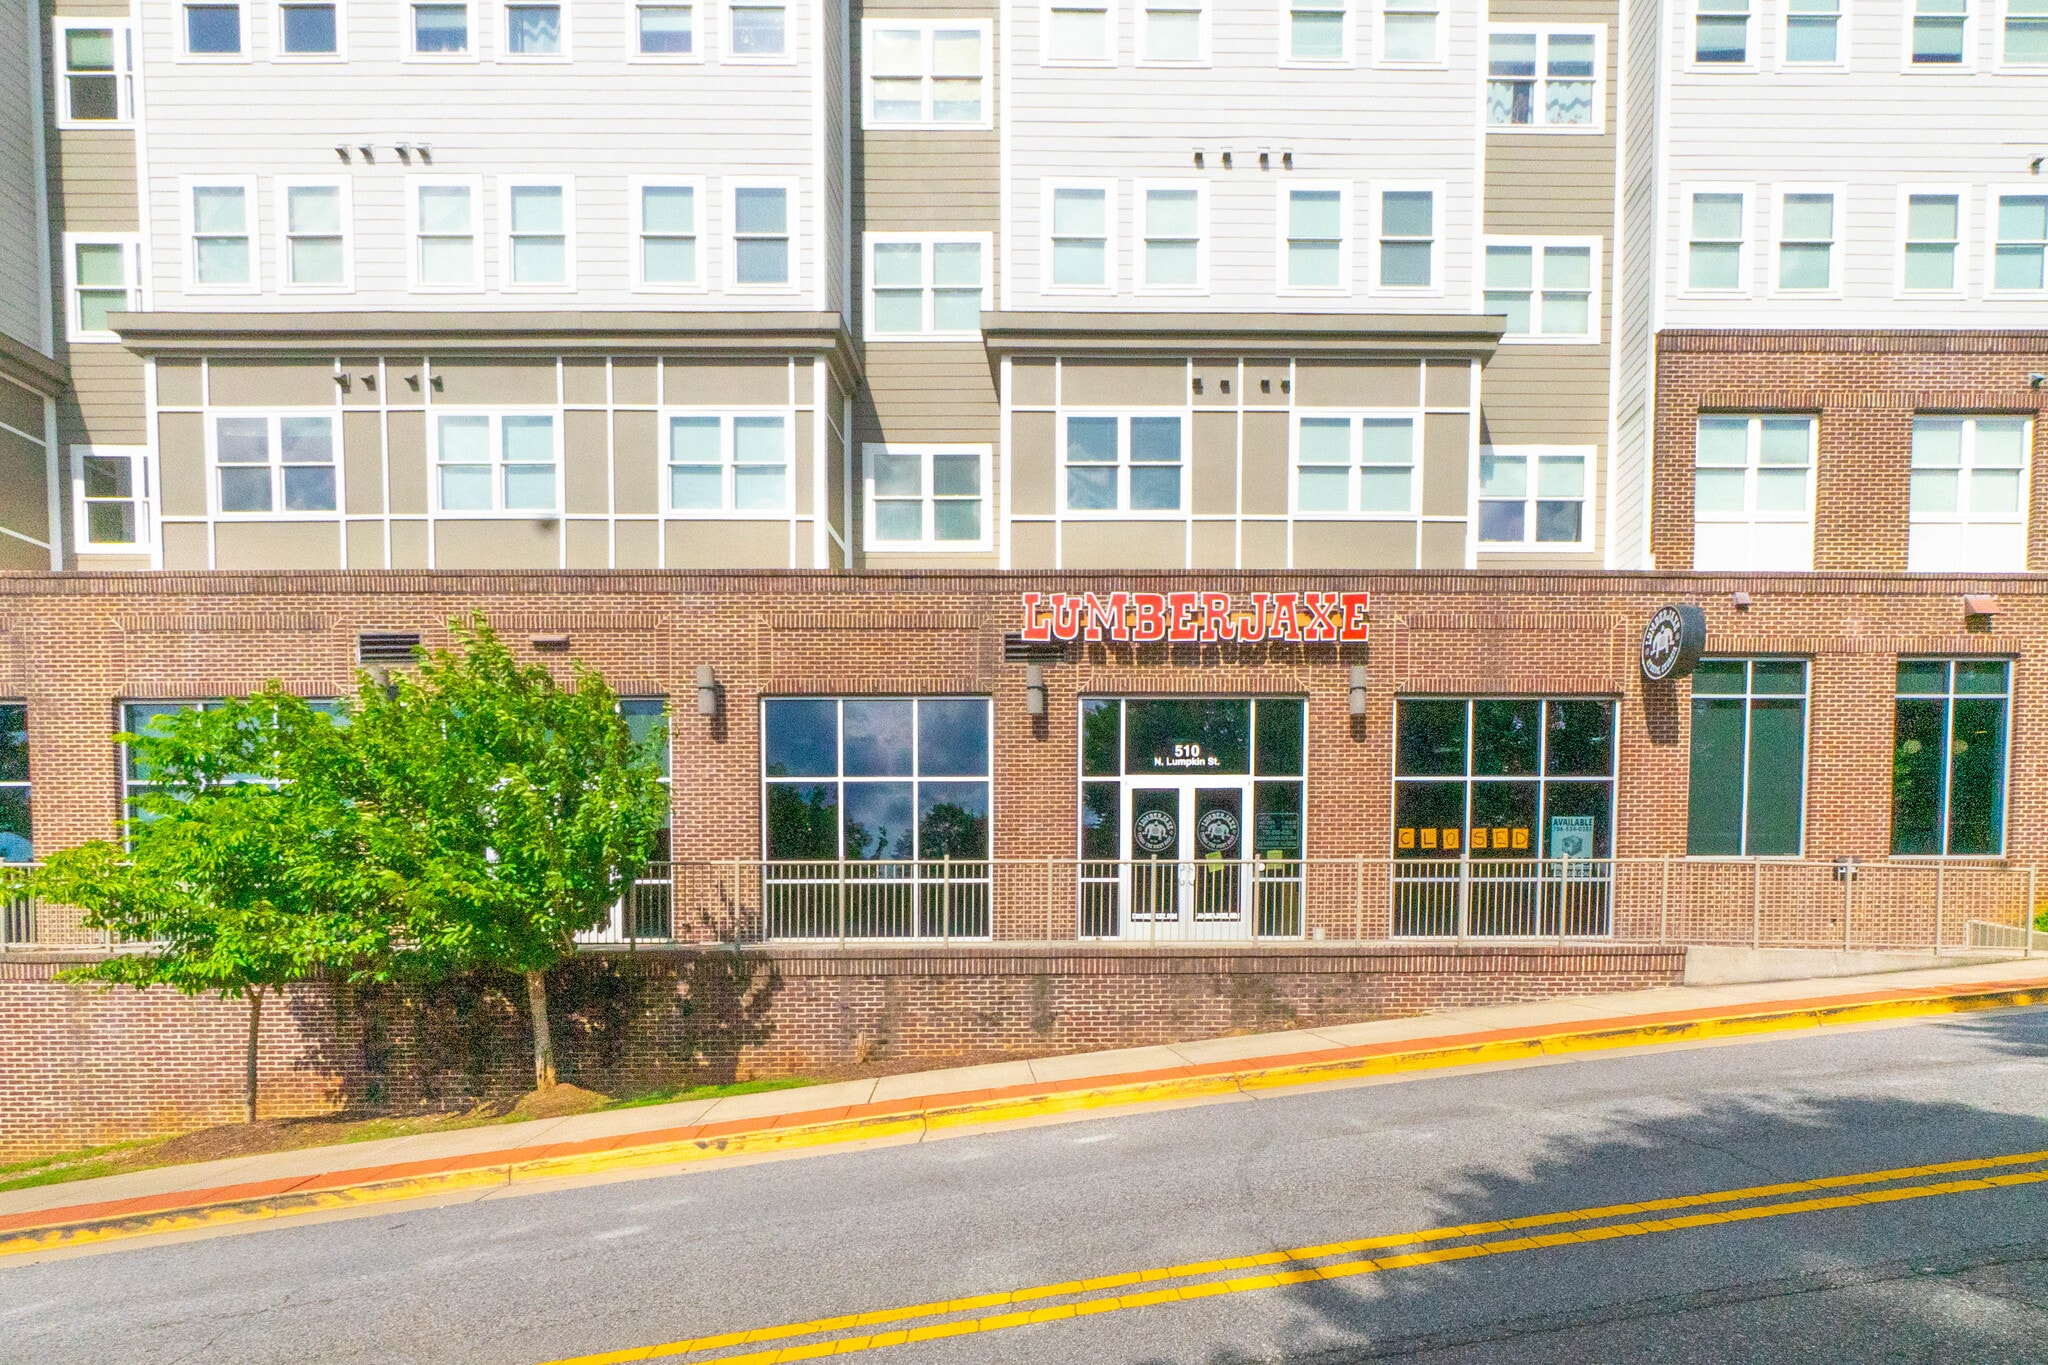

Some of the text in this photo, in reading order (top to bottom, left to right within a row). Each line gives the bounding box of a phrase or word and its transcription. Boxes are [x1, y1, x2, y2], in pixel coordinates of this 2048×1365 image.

[1021, 592, 1370, 642] LUMBERJAXE
[1175, 744, 1200, 757] 510
[1154, 757, 1220, 767] N. Lumpkin St.
[1553, 818, 1593, 827] AVAILABLE
